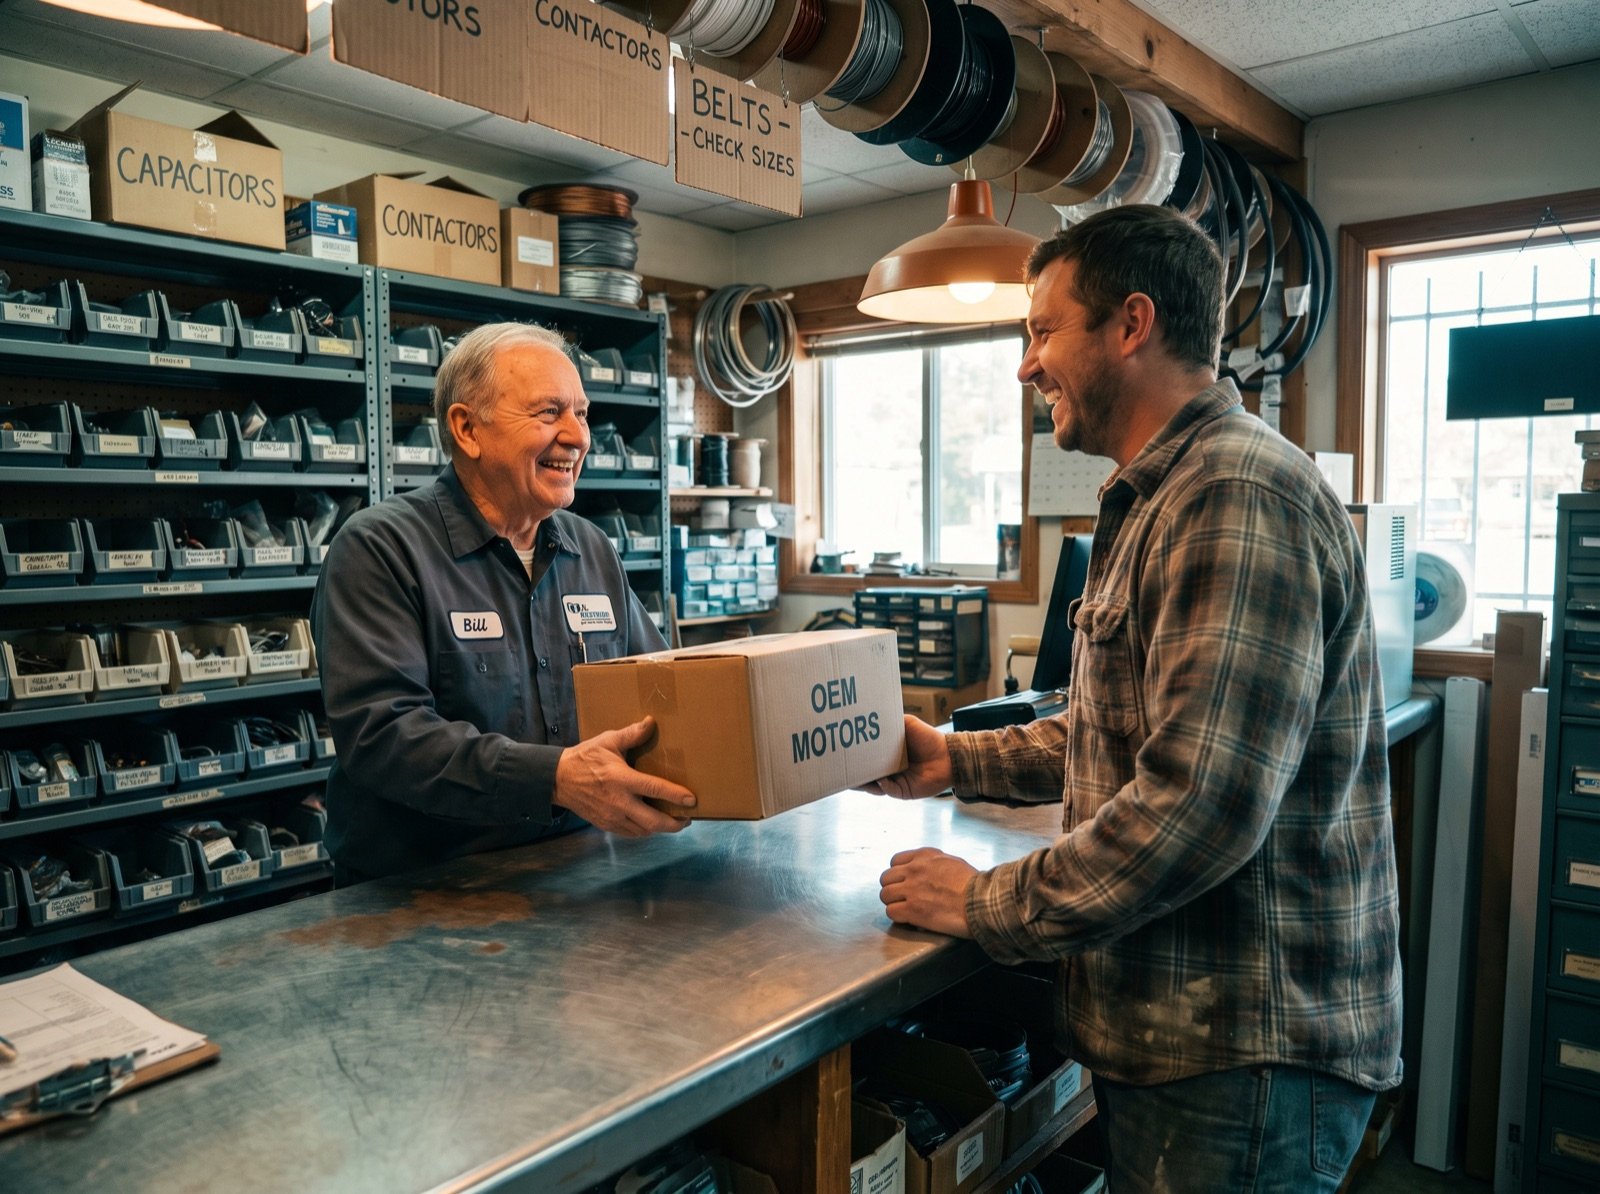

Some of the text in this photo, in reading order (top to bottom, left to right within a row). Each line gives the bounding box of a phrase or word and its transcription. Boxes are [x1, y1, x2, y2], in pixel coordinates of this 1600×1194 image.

[535, 0, 662, 71] CONTACTORS
[692, 78, 771, 136] BELTS
[116, 147, 277, 208] CAPACITORS
[751, 145, 795, 177] SIZES
[382, 204, 498, 254] CONTACTORS
[463, 618, 488, 632] Bill
[811, 675, 857, 714] OEM
[792, 711, 880, 764] MOTORS
